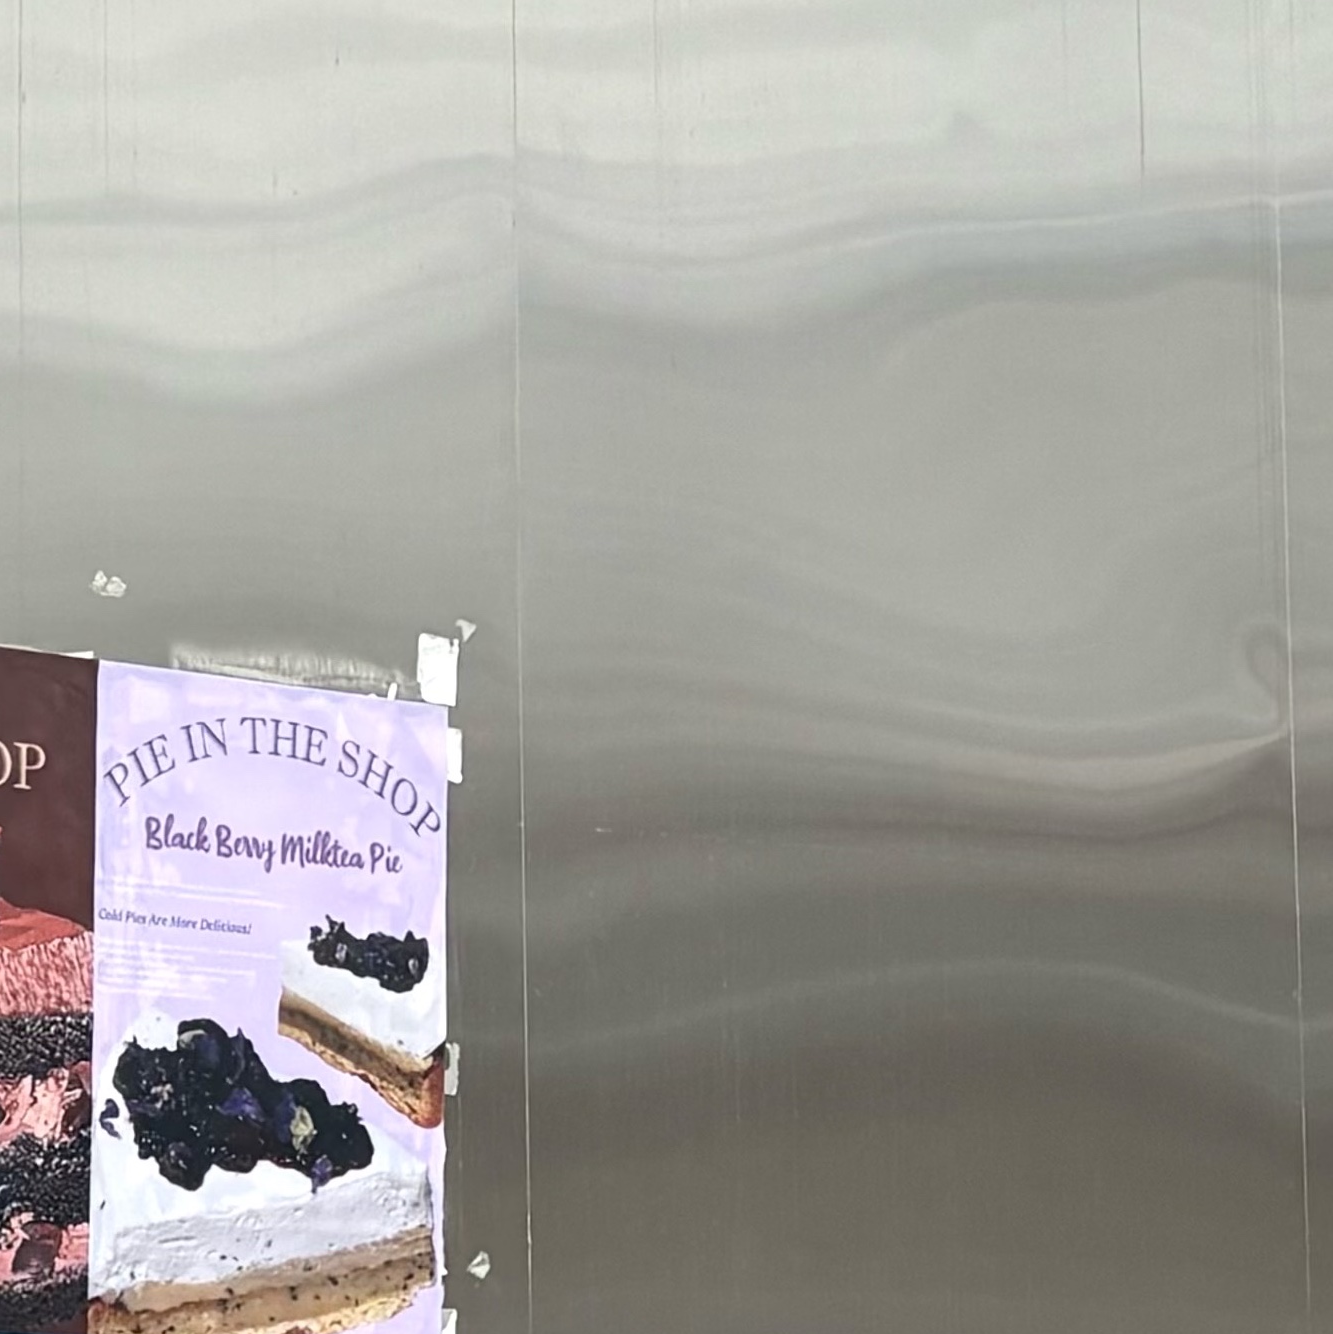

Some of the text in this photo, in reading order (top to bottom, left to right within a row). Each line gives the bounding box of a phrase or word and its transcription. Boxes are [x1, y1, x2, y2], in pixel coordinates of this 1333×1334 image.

[103, 716, 442, 838] PIE IN THE SHOP
[145, 813, 403, 874] Black Berry Milktea Pie
[98, 908, 252, 935] Cold Pies Are More Delicious!
